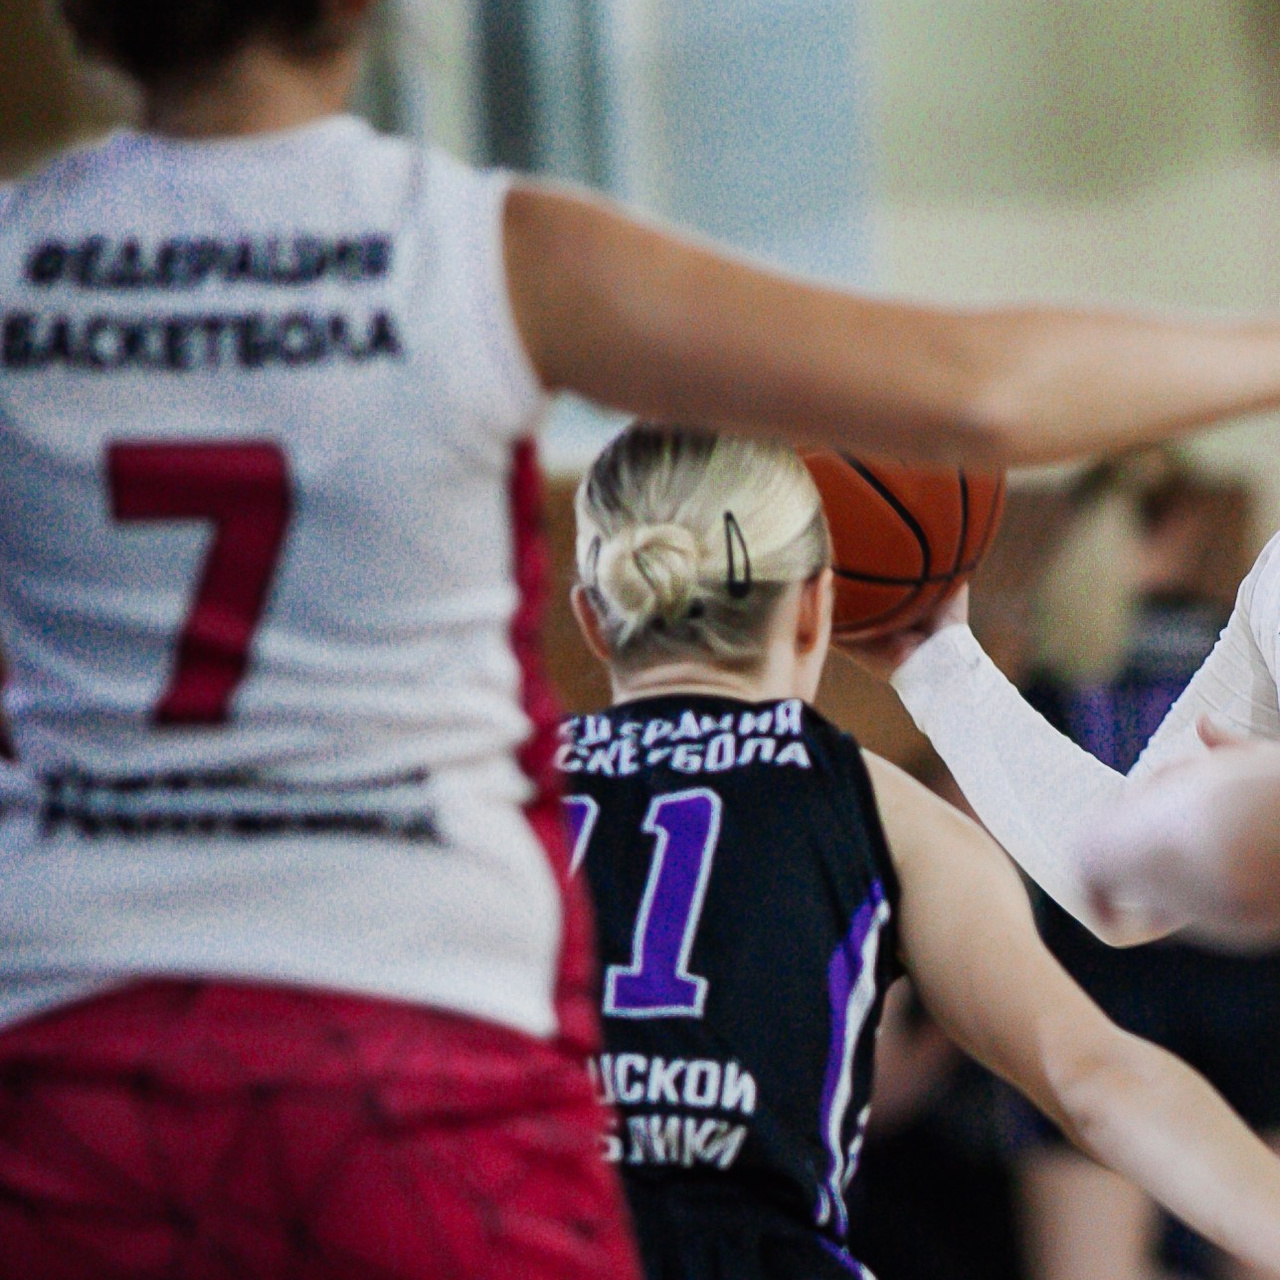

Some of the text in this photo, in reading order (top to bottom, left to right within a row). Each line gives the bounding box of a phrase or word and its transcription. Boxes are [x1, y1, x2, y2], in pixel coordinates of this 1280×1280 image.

[106, 440, 292, 727] 7
[557, 698, 803, 747] ЕДЕРАЦИЯ
[554, 732, 812, 777] СКЕТБОЛА
[600, 1113, 748, 1171] БЛИКИ
